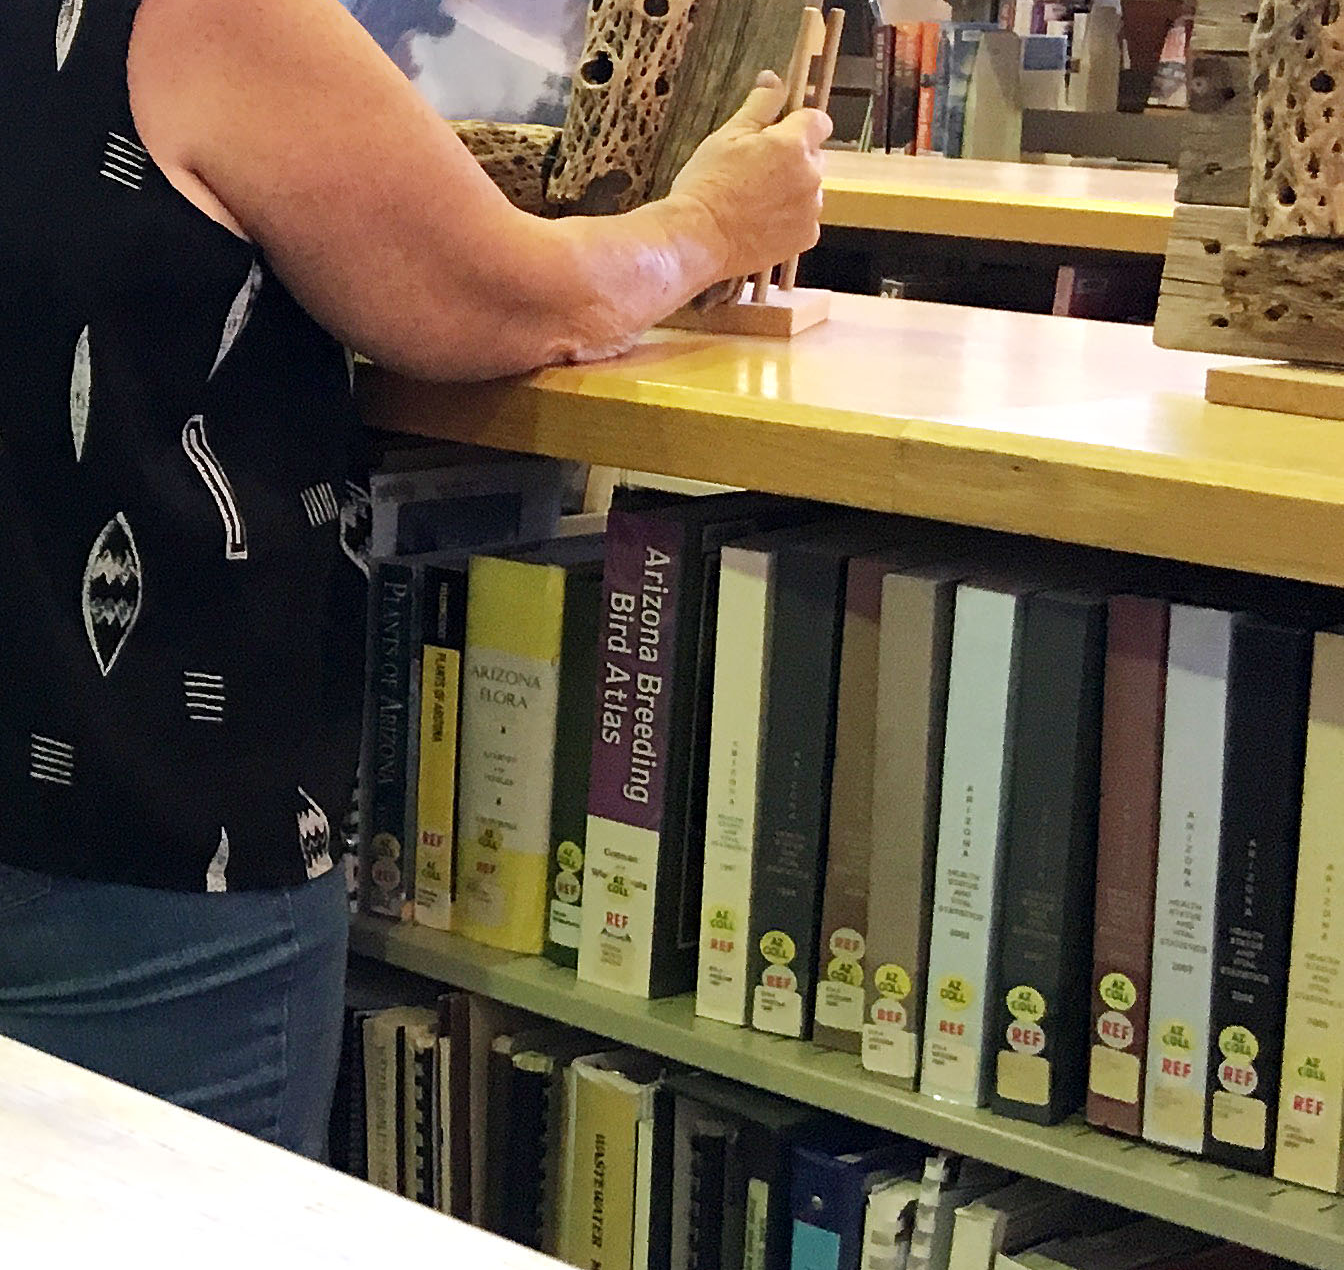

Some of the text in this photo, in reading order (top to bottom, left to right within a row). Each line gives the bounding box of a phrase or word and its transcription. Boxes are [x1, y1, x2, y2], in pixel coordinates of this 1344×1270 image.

[470, 665, 542, 691] ARIZONA
[601, 592, 635, 746] Bird Atlas
[623, 545, 671, 805] Arizona Breeding
[378, 581, 408, 783] PLANTS OF ARIZONA
[479, 686, 528, 709] FLORA
[613, 875, 625, 887] AZ
[606, 911, 629, 929] REF
[715, 910, 729, 920] AZ
[709, 938, 734, 953] REF
[766, 975, 792, 989] REF
[948, 979, 962, 992] AZ
[1112, 979, 1126, 991] AZ
[1018, 991, 1032, 1002] AZ
[877, 1008, 904, 1024] REF
[938, 1019, 965, 1037] REF
[1011, 1026, 1042, 1048] REF
[1101, 1020, 1130, 1041] REF
[1170, 1025, 1184, 1037] AZ
[1231, 1031, 1246, 1044] AZ
[1161, 1057, 1192, 1079] REF
[1305, 1056, 1321, 1069] AZ
[1223, 1065, 1254, 1088] REF
[1293, 1094, 1325, 1117] REF
[591, 1132, 607, 1249] WASTEWATER
